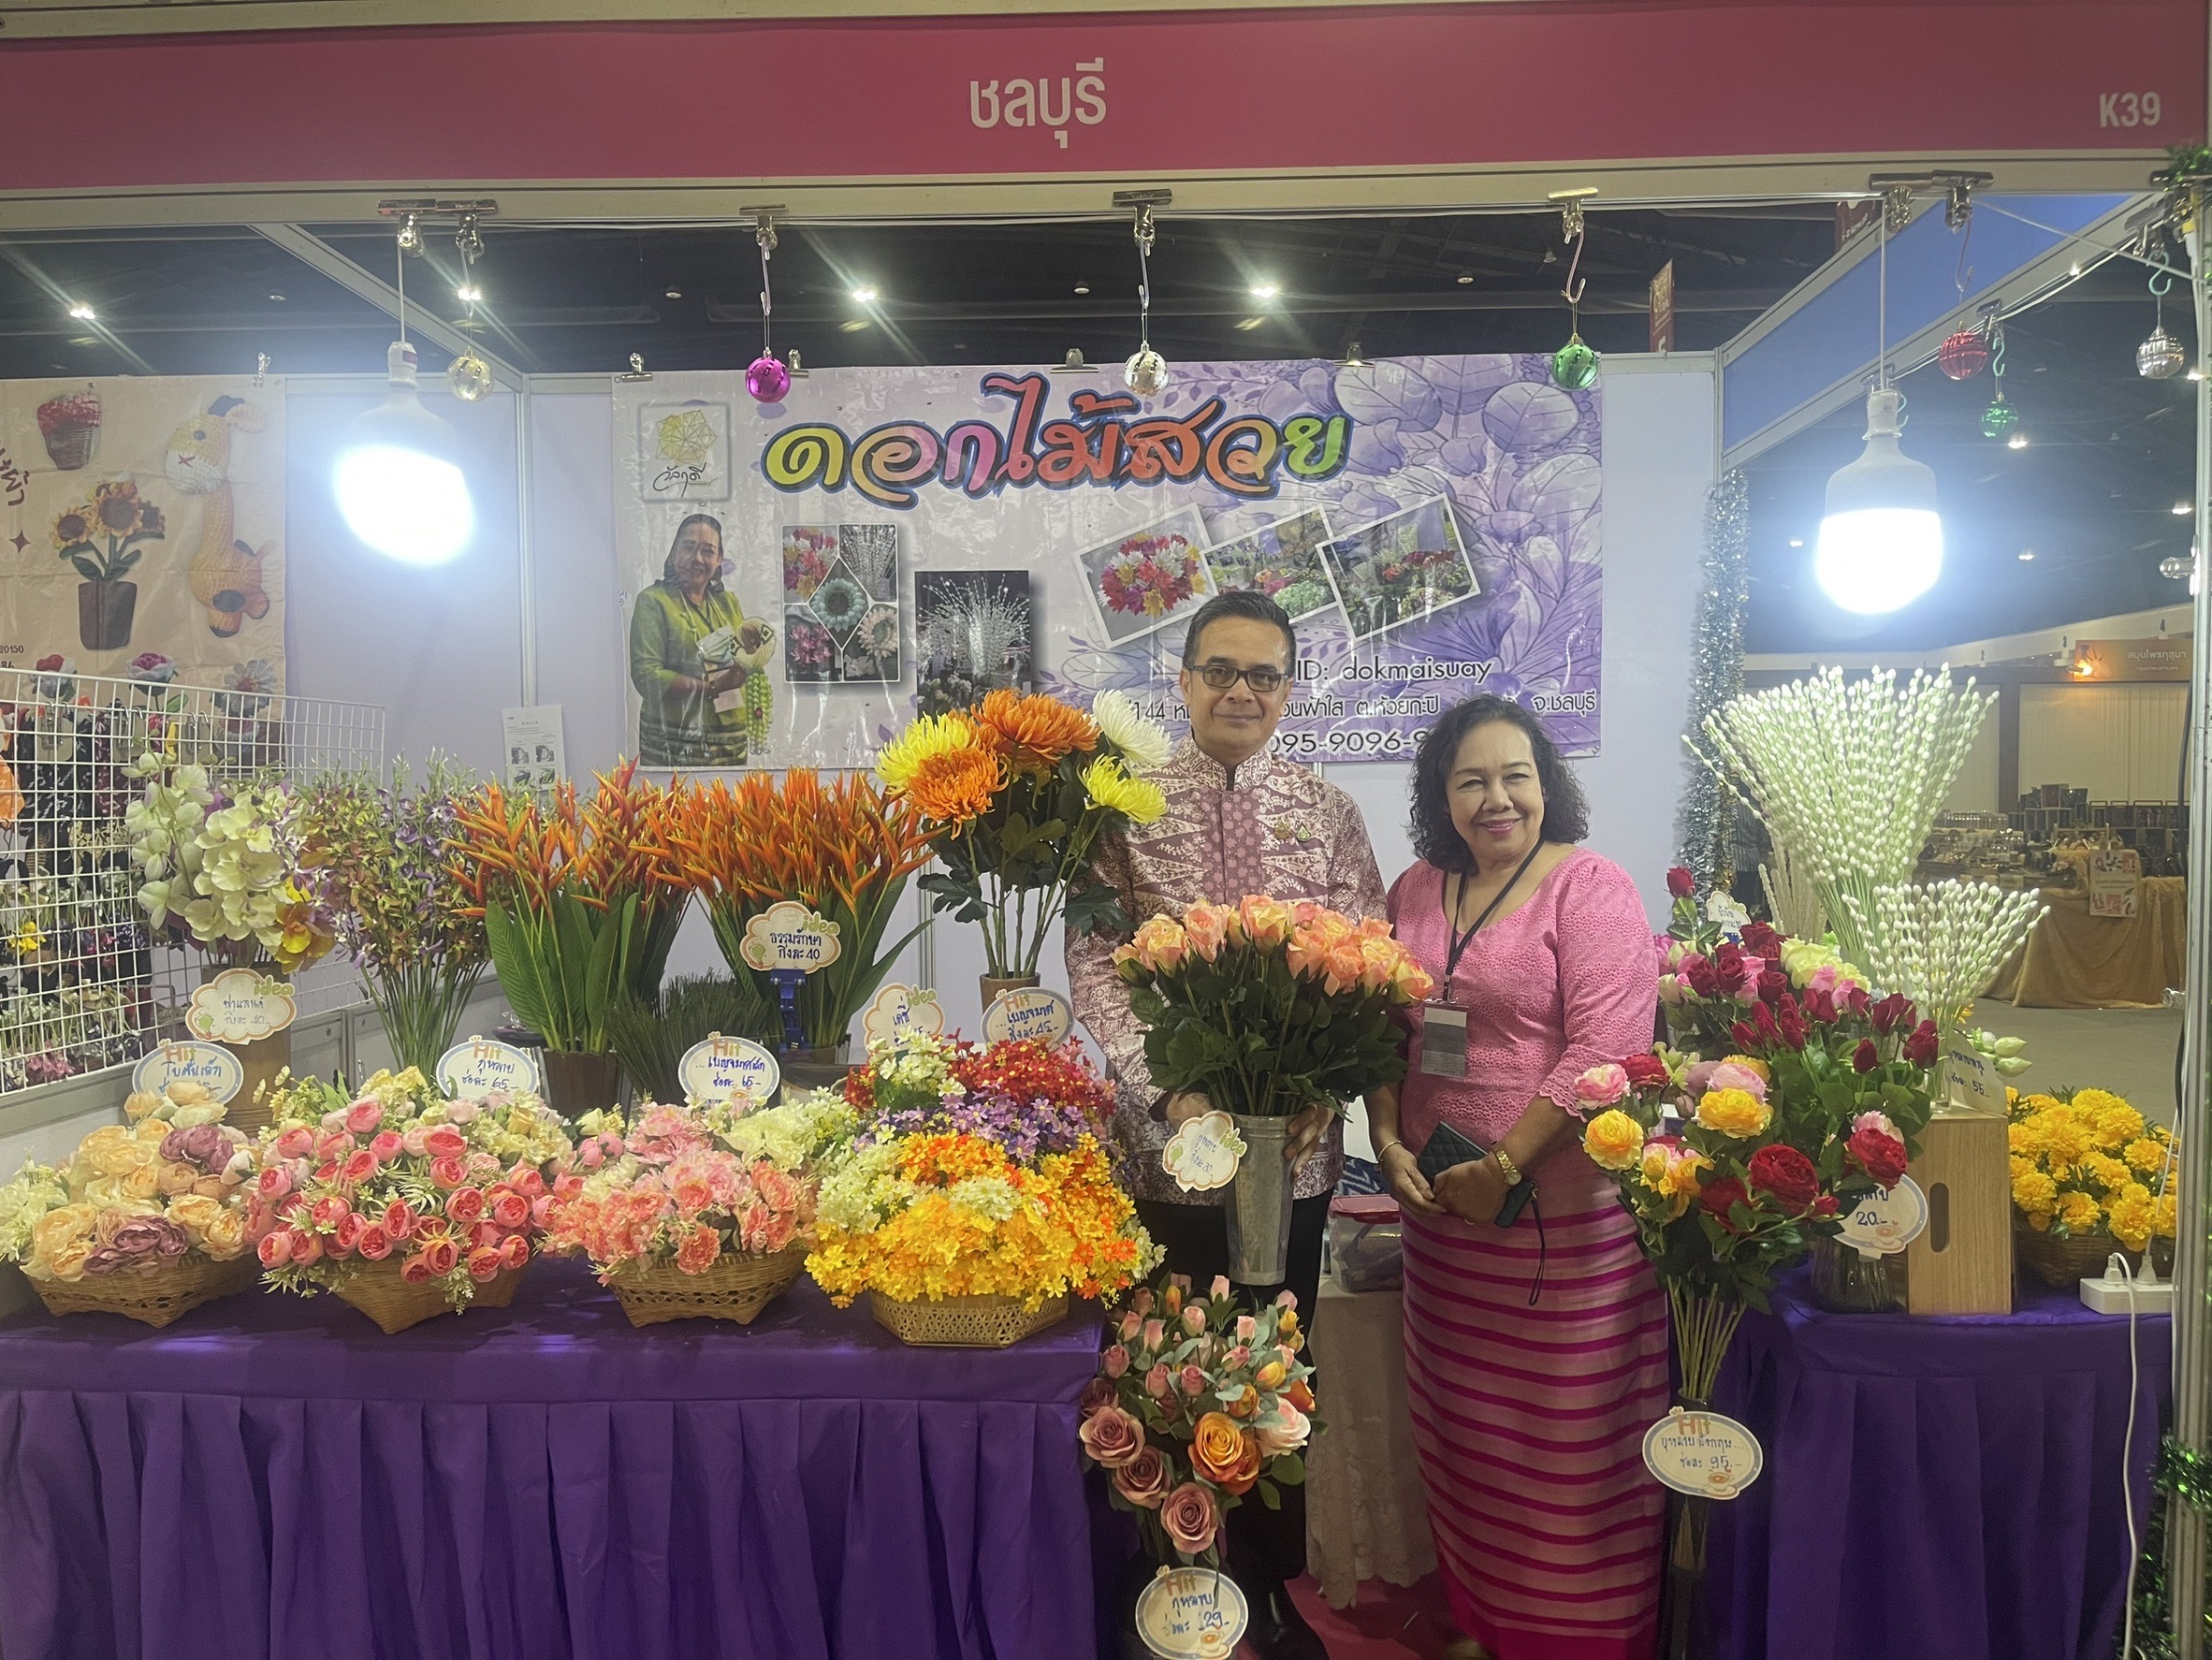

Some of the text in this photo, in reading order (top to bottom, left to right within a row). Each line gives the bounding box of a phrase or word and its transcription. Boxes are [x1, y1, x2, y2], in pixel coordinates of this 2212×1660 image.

[969, 57, 1107, 149] ชลบุรี
[2099, 91, 2161, 127] K39
[762, 372, 1351, 512] ดอกไม้สวย
[1297, 656, 1492, 684] ID: dokmaisuay
[1357, 694, 1439, 717] ต.ห้วยกะปิ
[1533, 691, 1596, 716] จ.ชลบุรี
[803, 912, 839, 934] idea
[806, 948, 821, 960] 40
[254, 976, 295, 997] idea
[906, 985, 937, 1007] idea
[165, 1044, 196, 1062] Hit
[473, 1041, 502, 1059] Hit
[713, 1038, 742, 1056] Hit
[477, 1058, 515, 1075] กุหลาบ
[1219, 1129, 1246, 1157] idea
[1677, 1414, 1711, 1436] Hit
[1165, 1572, 1196, 1596] Hit
[1172, 1594, 1214, 1618] กุหลาบ
